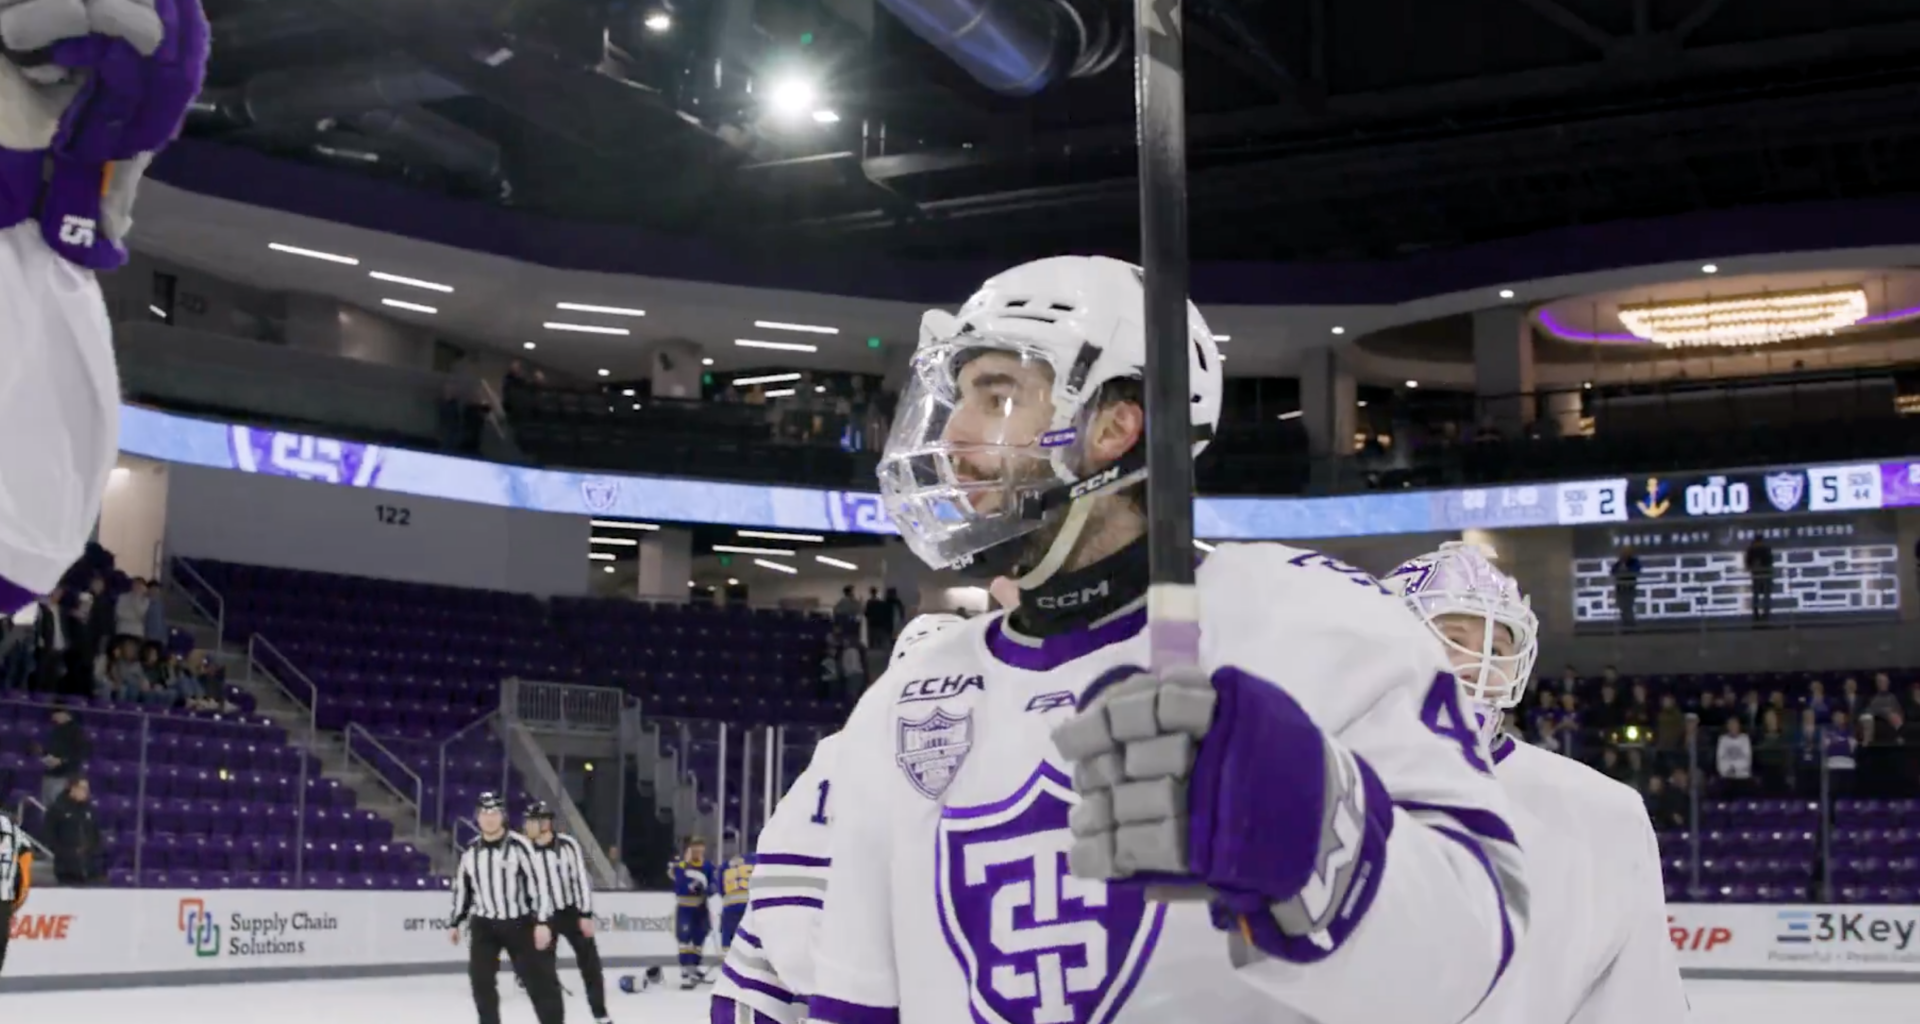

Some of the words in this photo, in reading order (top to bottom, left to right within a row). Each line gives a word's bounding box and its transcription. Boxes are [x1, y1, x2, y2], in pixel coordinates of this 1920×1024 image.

[1043, 432, 1075, 444] CCM
[1070, 466, 1119, 499] CCM
[1822, 475, 1838, 503] 5
[1599, 488, 1615, 515] 2
[1686, 482, 1749, 515] 00.0
[374, 503, 411, 526] 122
[1036, 580, 1109, 609] CCM
[899, 675, 984, 699] CCHA
[1419, 670, 1490, 776] 4
[230, 912, 288, 936] Supply
[291, 911, 338, 931] Chain
[593, 913, 610, 932] he
[1667, 915, 1731, 951] RIP
[1815, 912, 1916, 950] 3Key
[229, 936, 306, 955] Solutions
